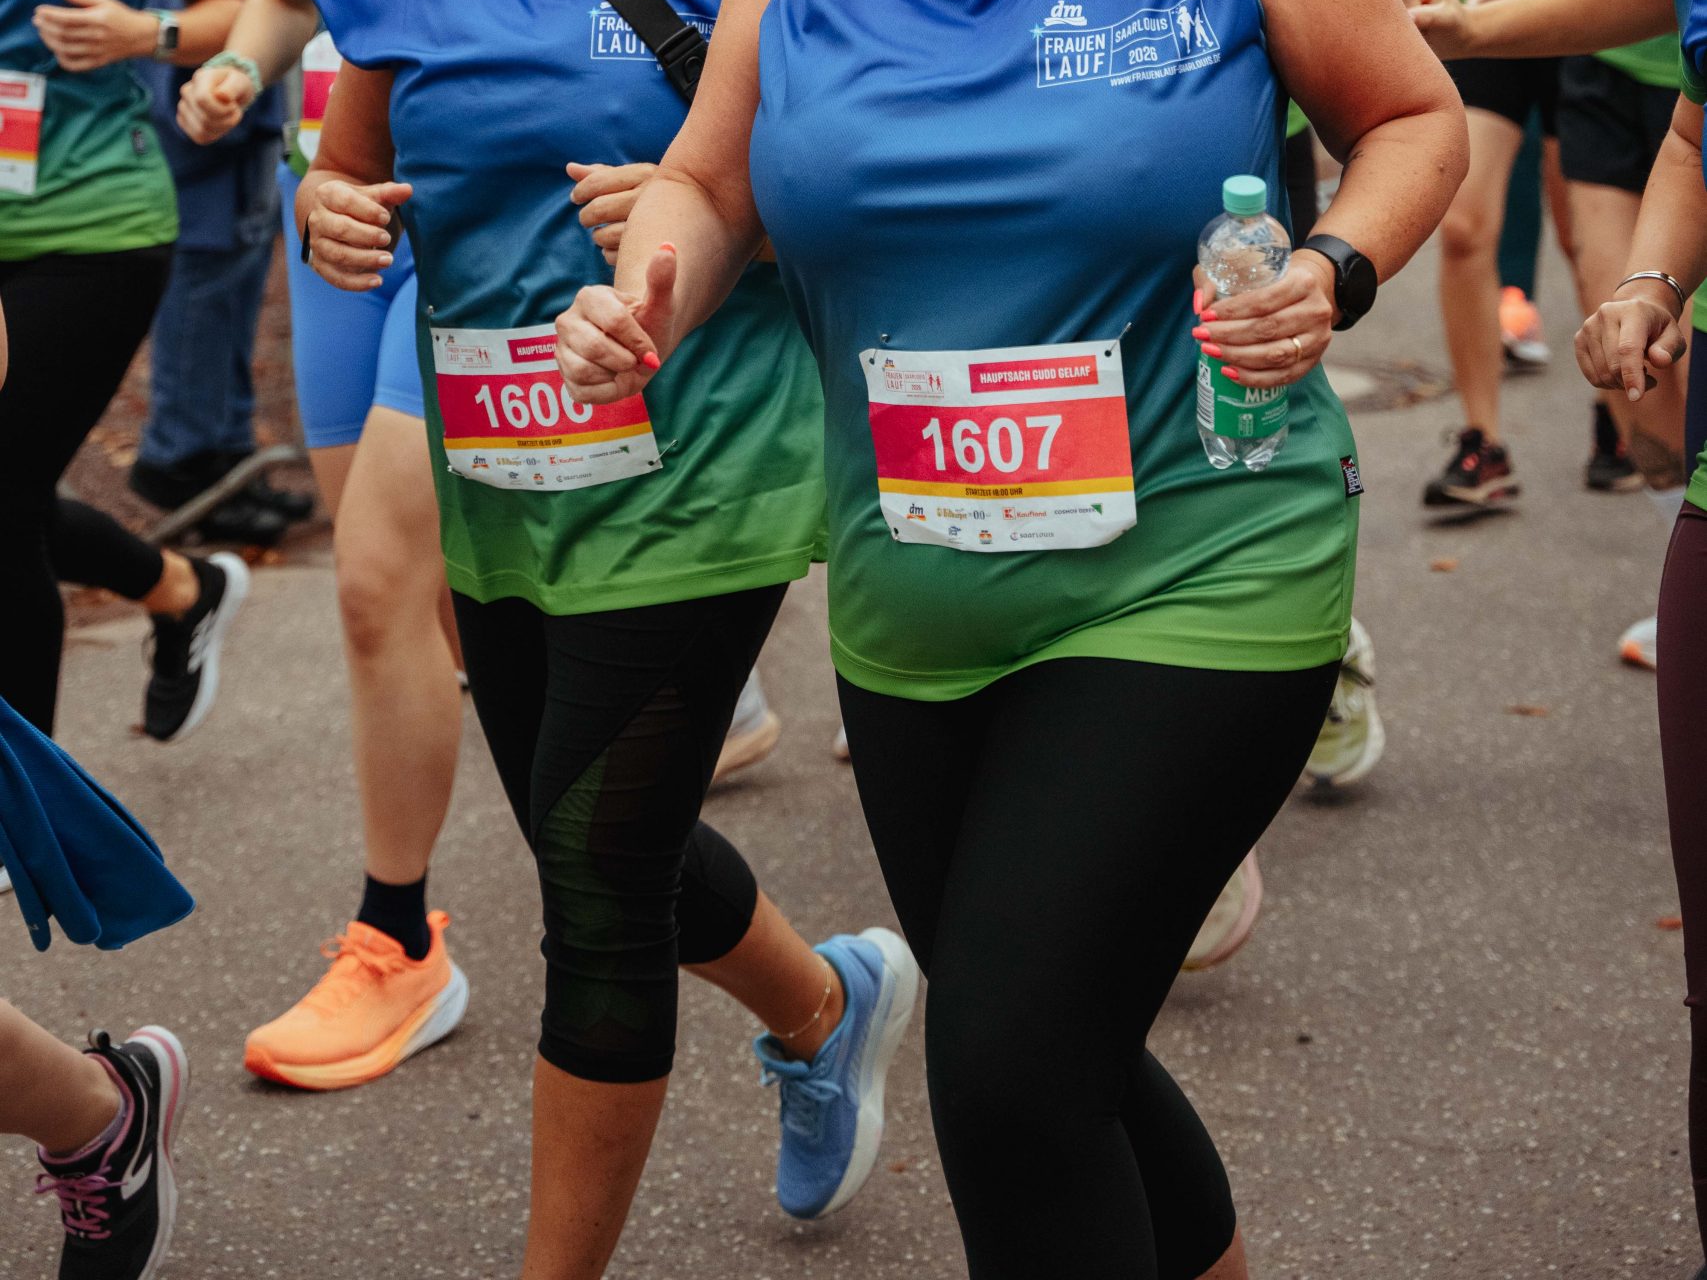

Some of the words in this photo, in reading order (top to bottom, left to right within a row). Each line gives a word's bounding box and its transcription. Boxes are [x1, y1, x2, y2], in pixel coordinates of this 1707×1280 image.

[1051, 0, 1083, 18] dm
[599, 16, 633, 31] FRAU
[1115, 18, 1168, 43] SAARLOUIS
[1045, 33, 1106, 55] FRAUEN
[1128, 46, 1158, 65] 2026
[1045, 53, 1106, 81] LAUF
[980, 370, 1031, 384] HAUPTSACH
[1032, 368, 1056, 381] GUDD
[1058, 365, 1091, 379] GELAAF
[922, 415, 1063, 473] 1607
[1010, 487, 1023, 496] UHR
[1017, 509, 1047, 518] Kaufland
